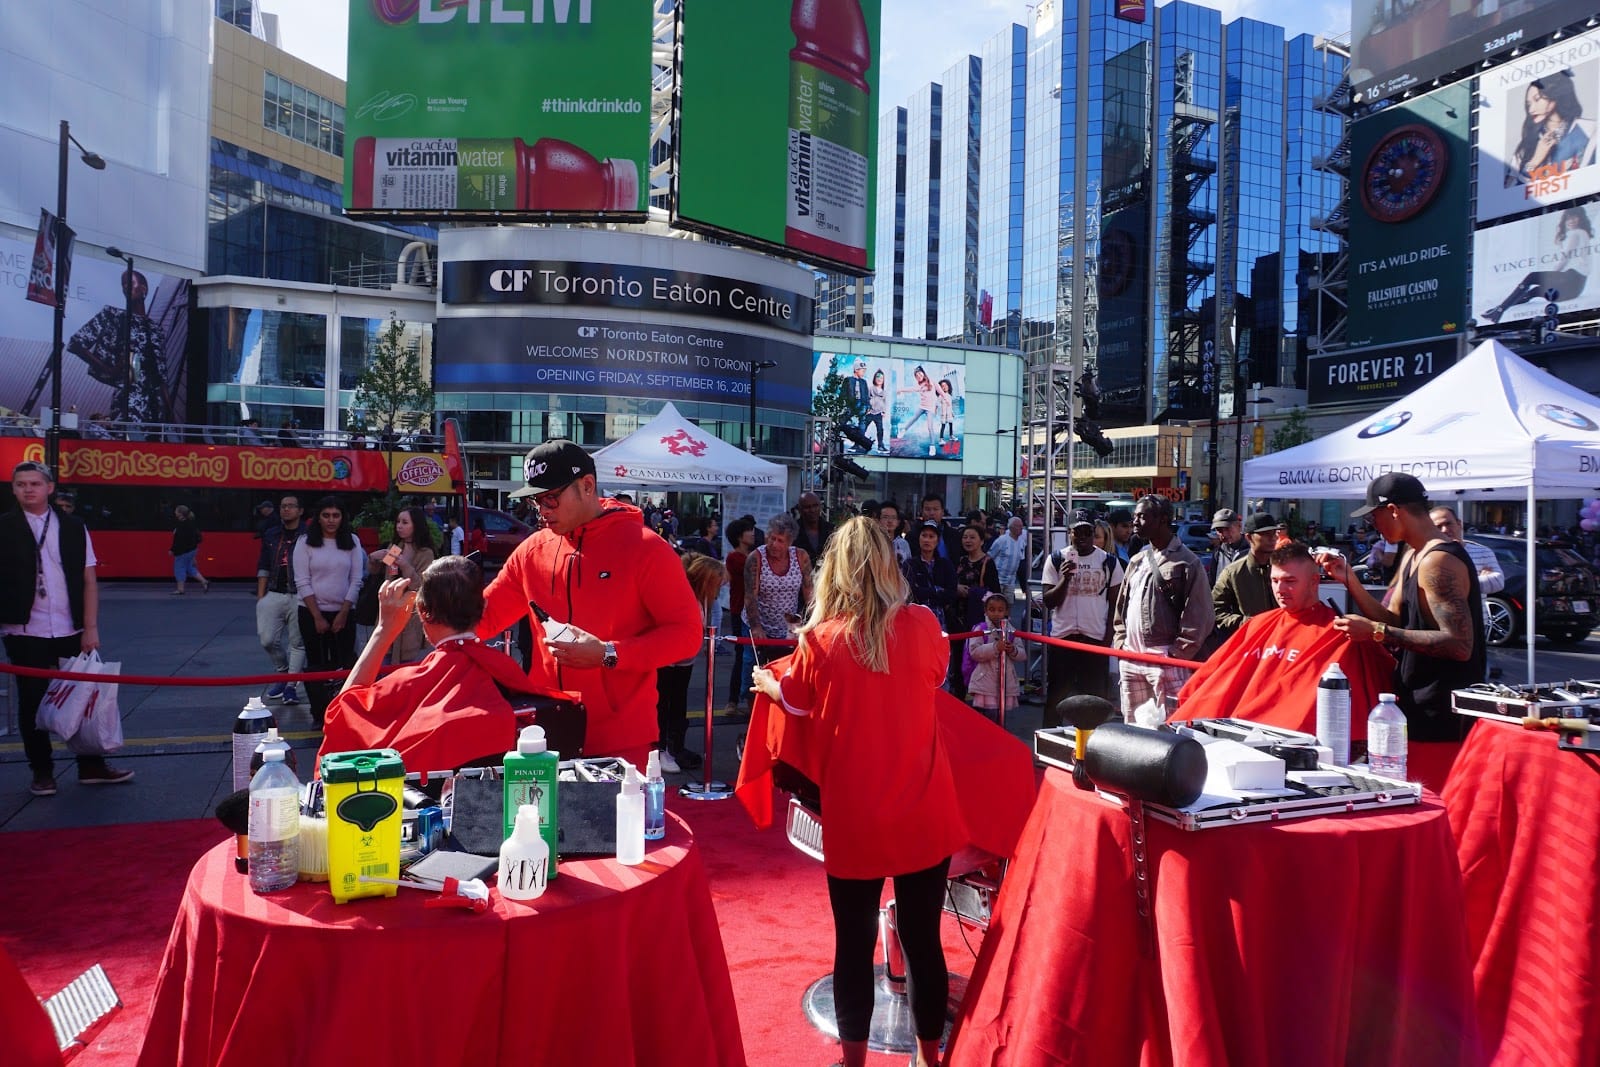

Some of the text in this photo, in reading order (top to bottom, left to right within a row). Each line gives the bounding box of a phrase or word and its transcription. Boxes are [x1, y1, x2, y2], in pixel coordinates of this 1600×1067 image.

[1483, 29, 1523, 53] 3:26 PM
[1367, 85, 1380, 100] 16
[542, 98, 642, 114] #thinkdrinkdo
[1527, 160, 1567, 183] YOU
[1524, 174, 1571, 200] FIRST
[1358, 244, 1451, 275] IT'S A WILD RIDE.
[1493, 257, 1537, 273] VINCE
[489, 269, 792, 320] CF Toronto Eaton Centre
[1367, 278, 1439, 304] FALLSVIEW CASINO
[577, 326, 724, 349] CF Toronto Eaton Centre
[526, 345, 599, 359] WELCOMES
[606, 348, 689, 366] NORDSTROM
[695, 355, 711, 367] TO
[1328, 352, 1433, 385] FOREVER 21
[536, 368, 595, 383] OPENING
[599, 371, 644, 386] FRIDAY,
[646, 375, 713, 391] SEPTEMBER
[716, 381, 729, 393] 16,
[238, 451, 334, 483] Toronto
[402, 465, 442, 480] OFFICIAL
[629, 469, 774, 484] CANADA'S WALK OF FAME
[1279, 469, 1315, 486] BMW
[1328, 464, 1375, 483] BORN
